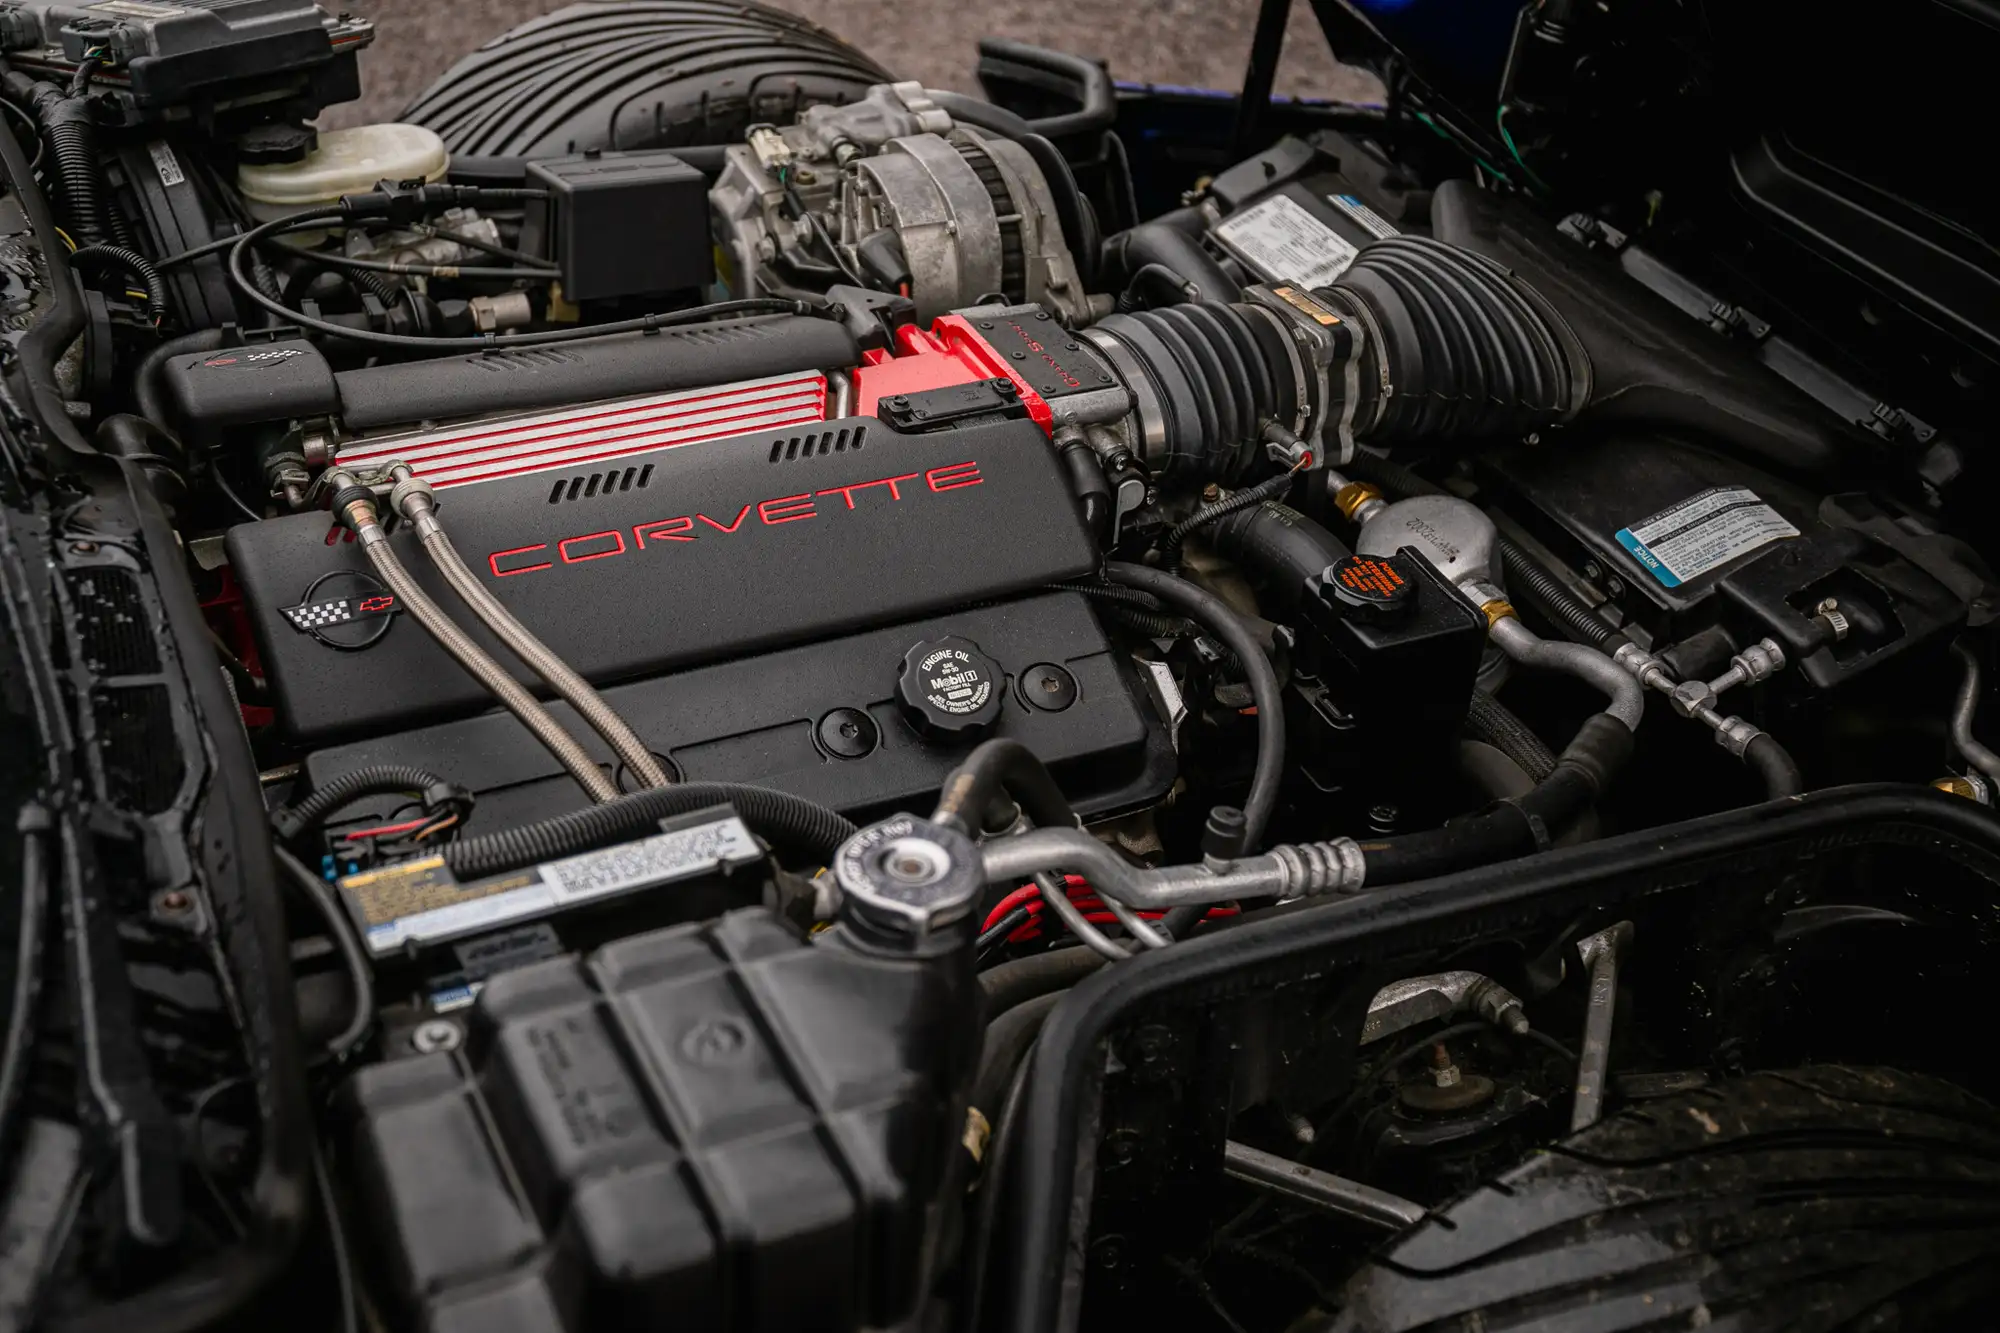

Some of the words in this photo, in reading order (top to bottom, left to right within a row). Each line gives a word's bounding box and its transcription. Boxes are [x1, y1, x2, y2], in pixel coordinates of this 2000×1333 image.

[488, 461, 985, 577] CORVETTE
[1633, 545, 1660, 569] NOTICE
[922, 650, 953, 672] ENGINE
[955, 650, 970, 663] OIL
[931, 673, 966, 690] Mobil
[927, 694, 948, 711] SPECIAL
[946, 699, 971, 707] OWNER'S
